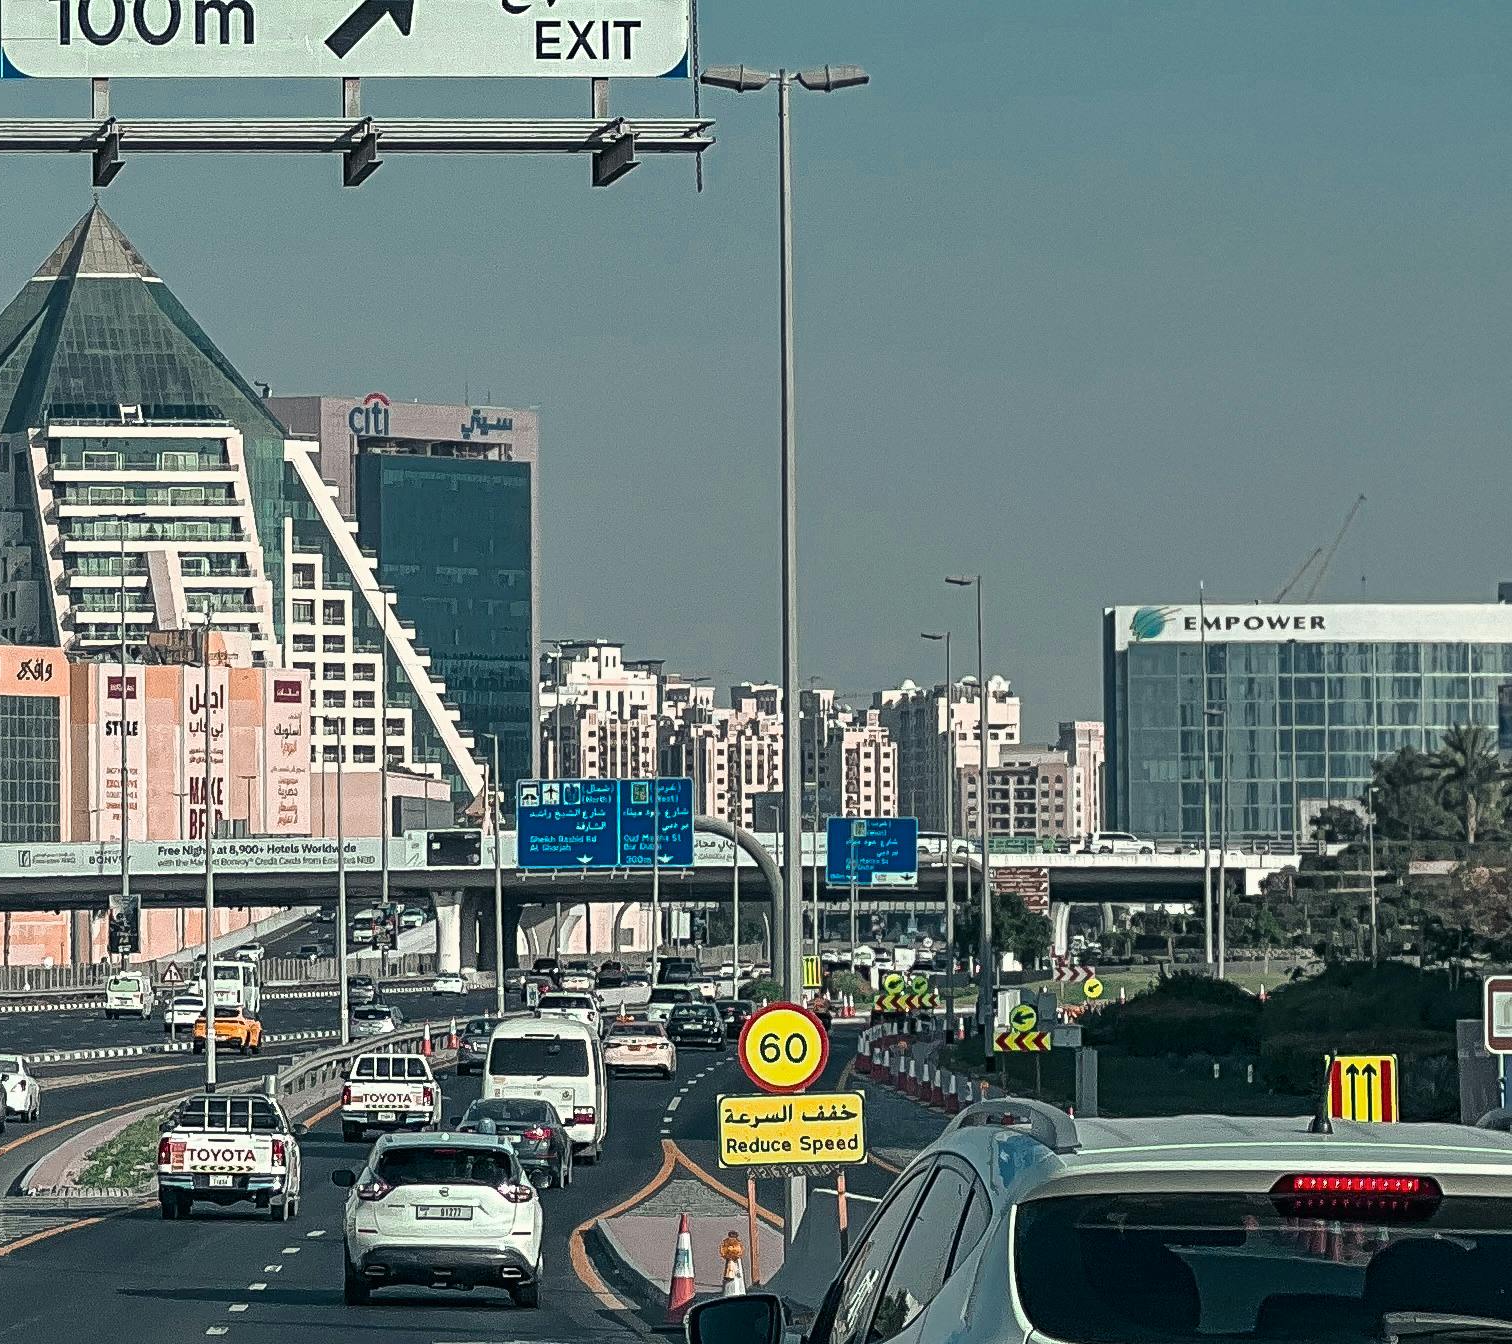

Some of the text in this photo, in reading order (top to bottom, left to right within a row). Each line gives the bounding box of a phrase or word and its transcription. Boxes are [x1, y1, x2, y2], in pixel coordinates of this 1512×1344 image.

[534, 20, 642, 61] EXIT
[1184, 614, 1326, 630] EMPOWER
[158, 842, 356, 857] Free Nighs at 8,900+ Hotels Worldwde
[89, 855, 132, 864] BONVY
[760, 1033, 807, 1063] 60
[363, 1093, 412, 1103] TOYOTA
[725, 1104, 857, 1128] خفف السرعة
[726, 1134, 858, 1154] Reduce Speed
[187, 1148, 256, 1162] TOYOTA
